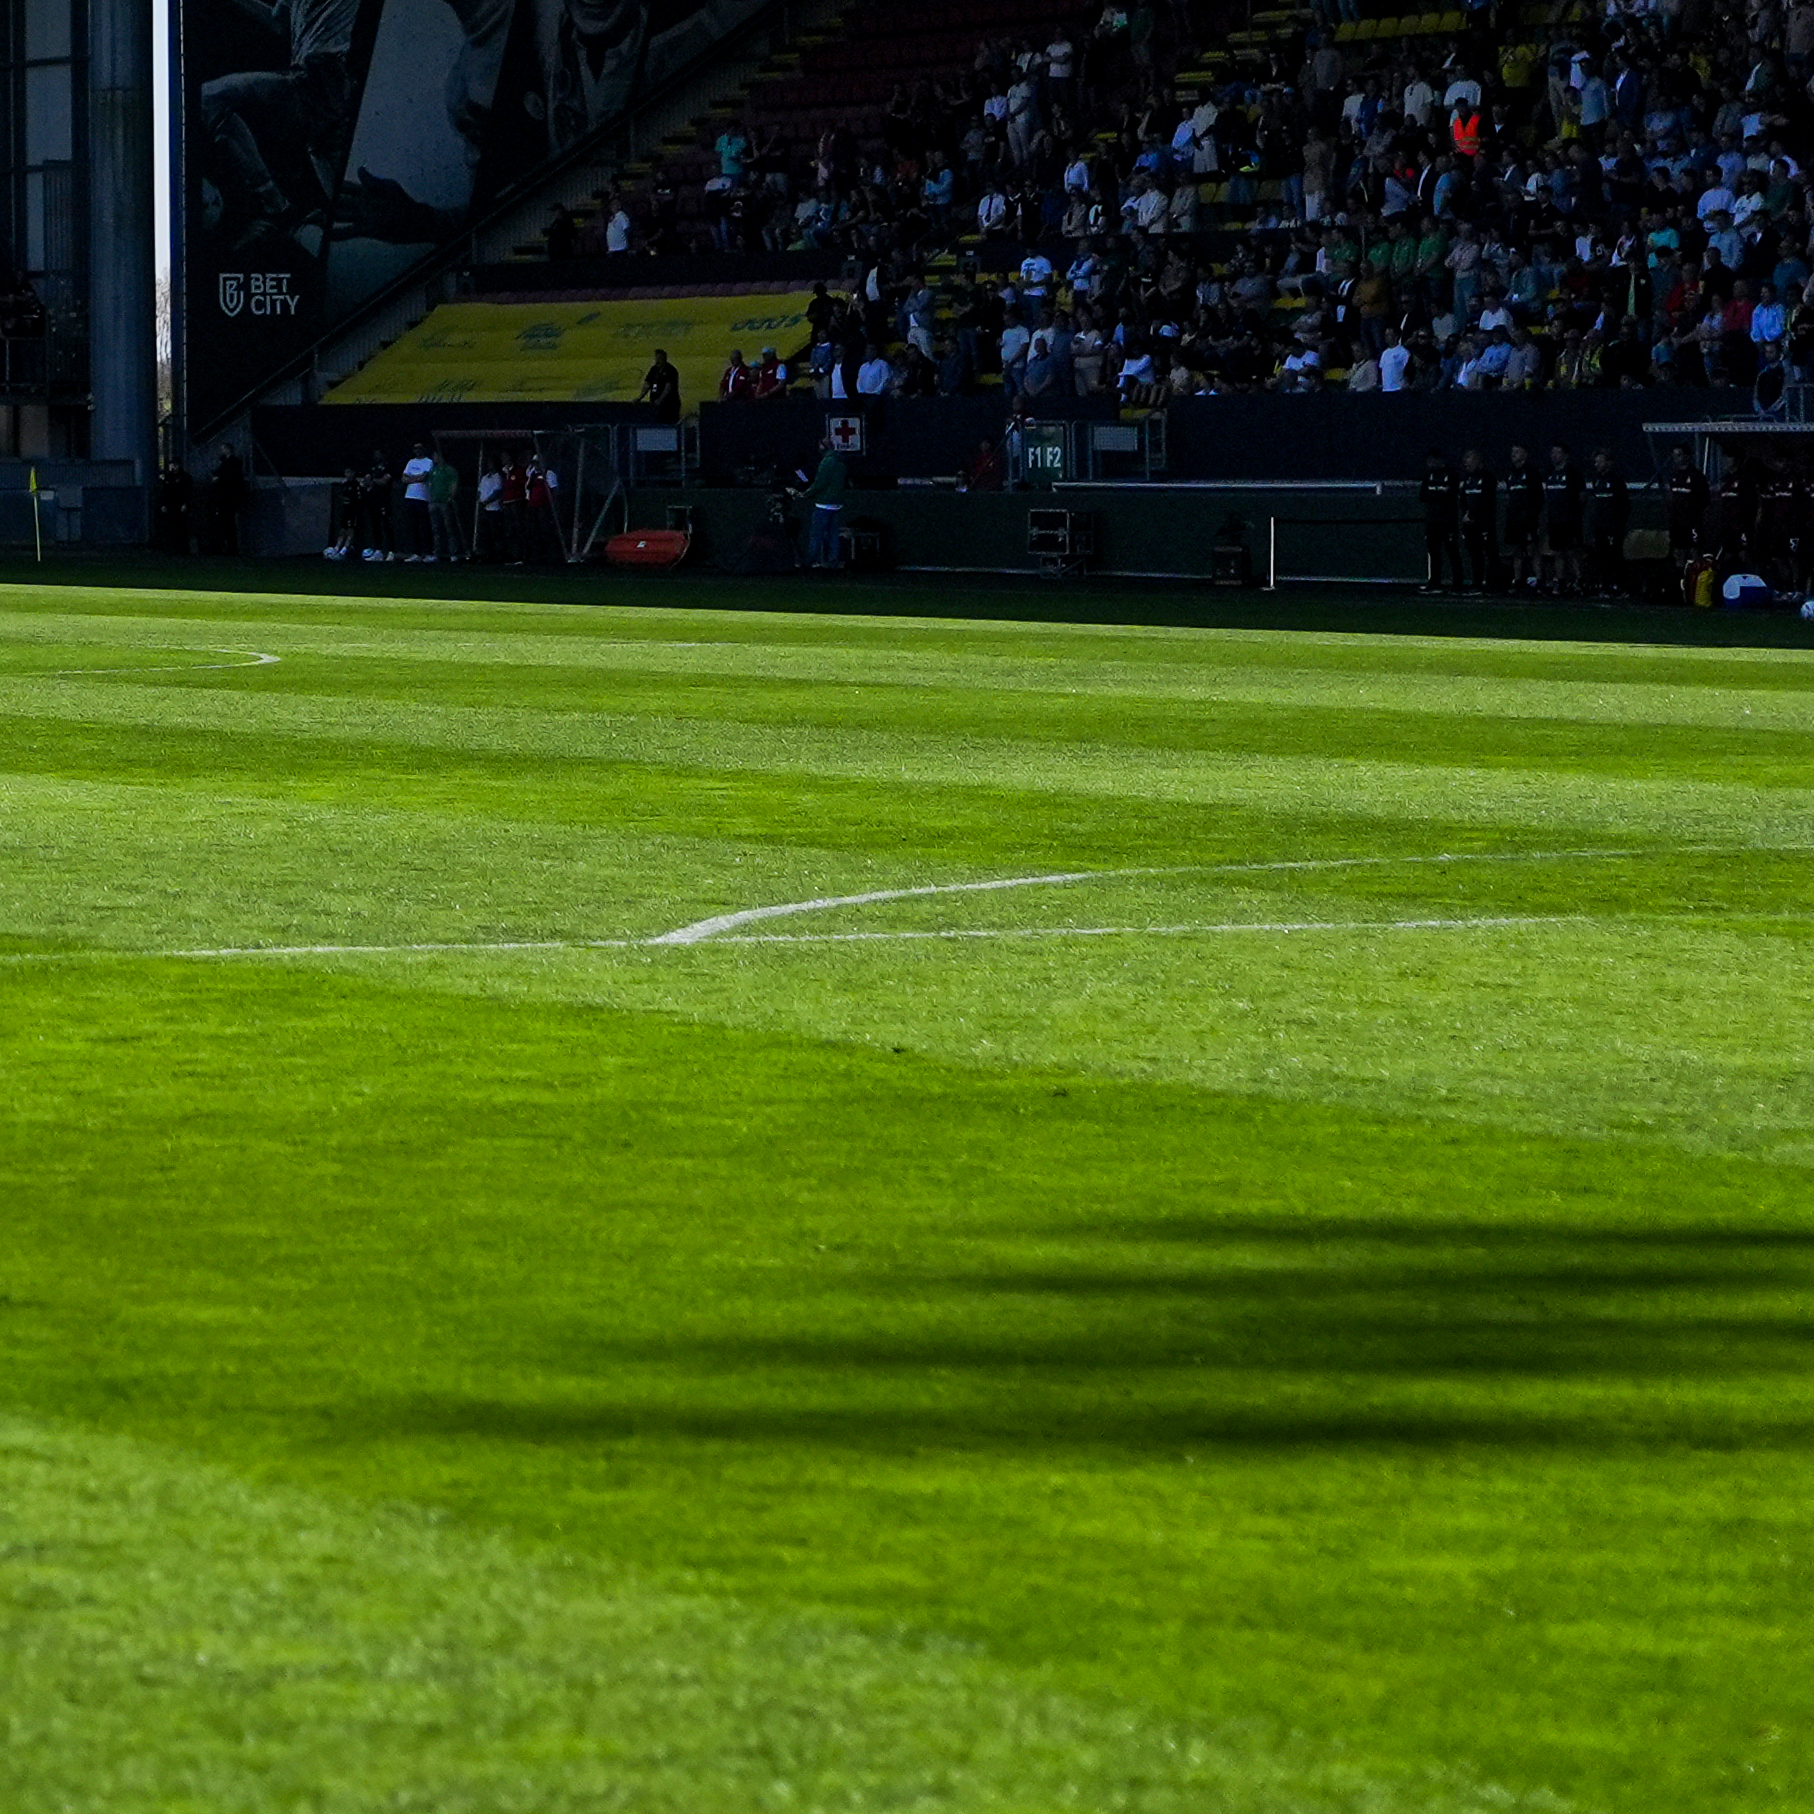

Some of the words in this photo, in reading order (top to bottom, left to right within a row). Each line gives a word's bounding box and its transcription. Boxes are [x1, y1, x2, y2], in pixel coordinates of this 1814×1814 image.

[250, 273, 292, 294] BET
[250, 295, 300, 316] CITY
[1046, 446, 1062, 469] F2
